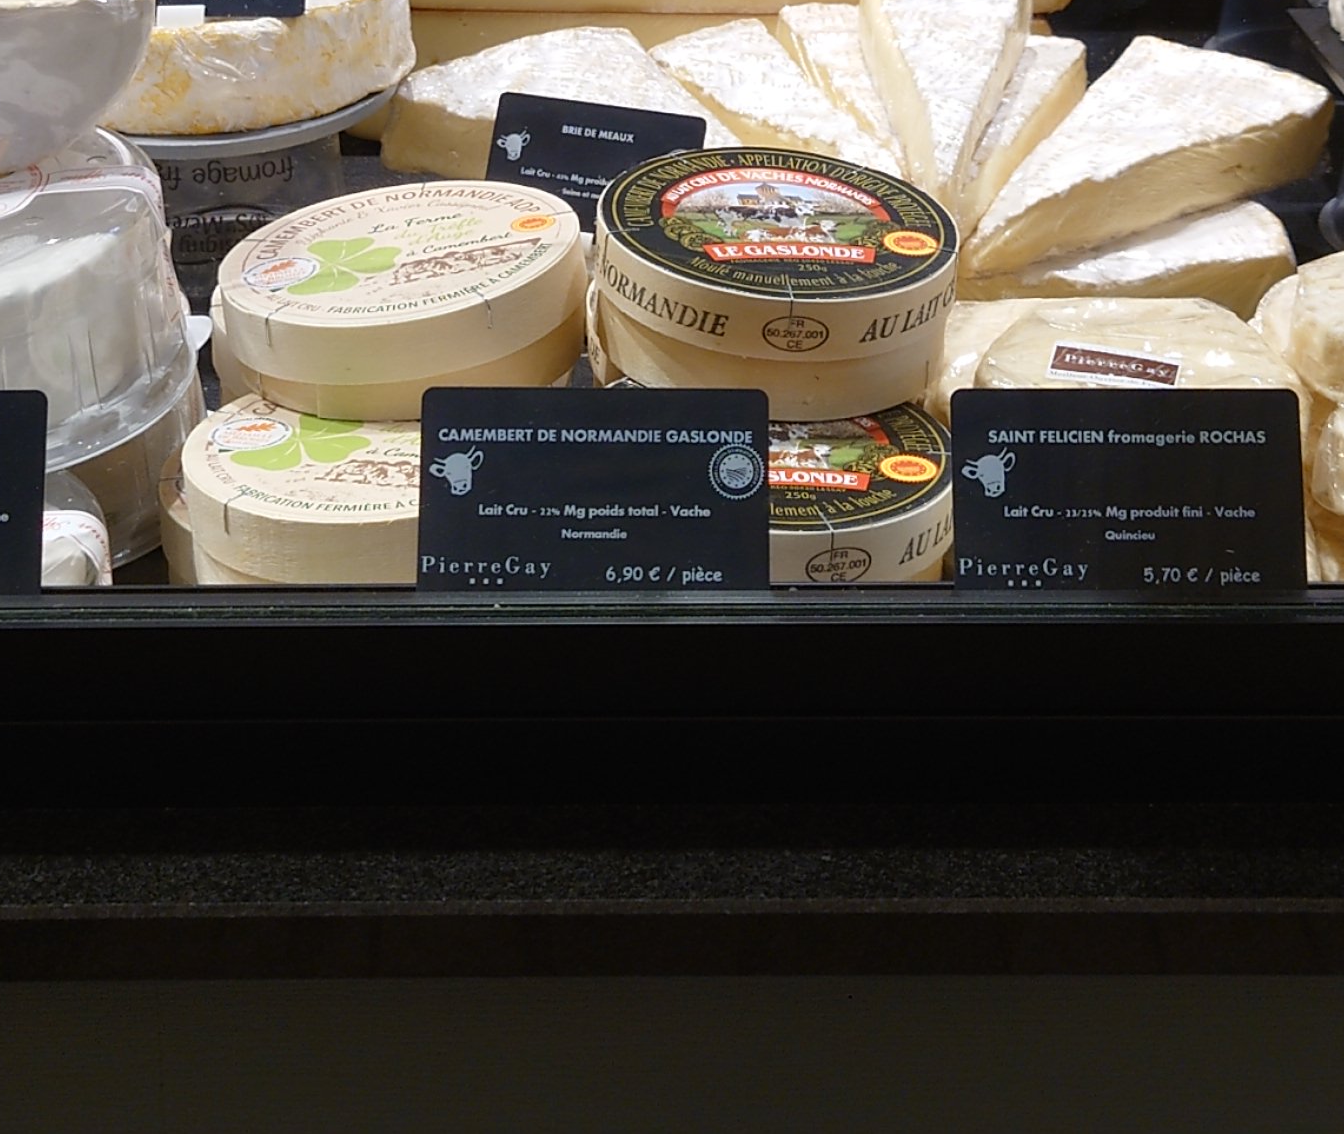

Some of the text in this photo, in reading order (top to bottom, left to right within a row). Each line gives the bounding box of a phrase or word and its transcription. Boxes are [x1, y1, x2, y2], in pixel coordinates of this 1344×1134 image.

[562, 125, 634, 143] BRIE DE MEAUX
[521, 167, 535, 175] Lait
[737, 154, 832, 176] APPELLATION
[742, 171, 803, 183] VACHES
[257, 189, 509, 260] CAMEMBERT DE NORMANDIE
[712, 244, 865, 259] LE GASLONDE
[327, 243, 553, 314] FABRICATION FERMIÈRE CAMEMBERT
[732, 267, 833, 287] manuellement
[859, 297, 942, 345] AU LAIT
[765, 328, 825, 340] 50.267.001
[787, 340, 803, 350] CE
[439, 429, 752, 444] CAMEMBERT DE NORMANDIE GASLONDE
[989, 430, 1265, 446] SAINT FELICIEN fromagerie ROCHAS
[234, 484, 311, 510] FABRICATION
[479, 504, 710, 519] Lait Cru Mg poids total Vache
[1004, 506, 1255, 520] Lait Cru Mg produit fini Vache
[562, 529, 627, 538] Normandie
[1105, 530, 1155, 540] Quincieu
[422, 556, 550, 578] PierreGay
[606, 566, 722, 585] 6,90 pièce
[959, 558, 1088, 580] PierreGay
[1144, 567, 1260, 586] 5,70 pièce
